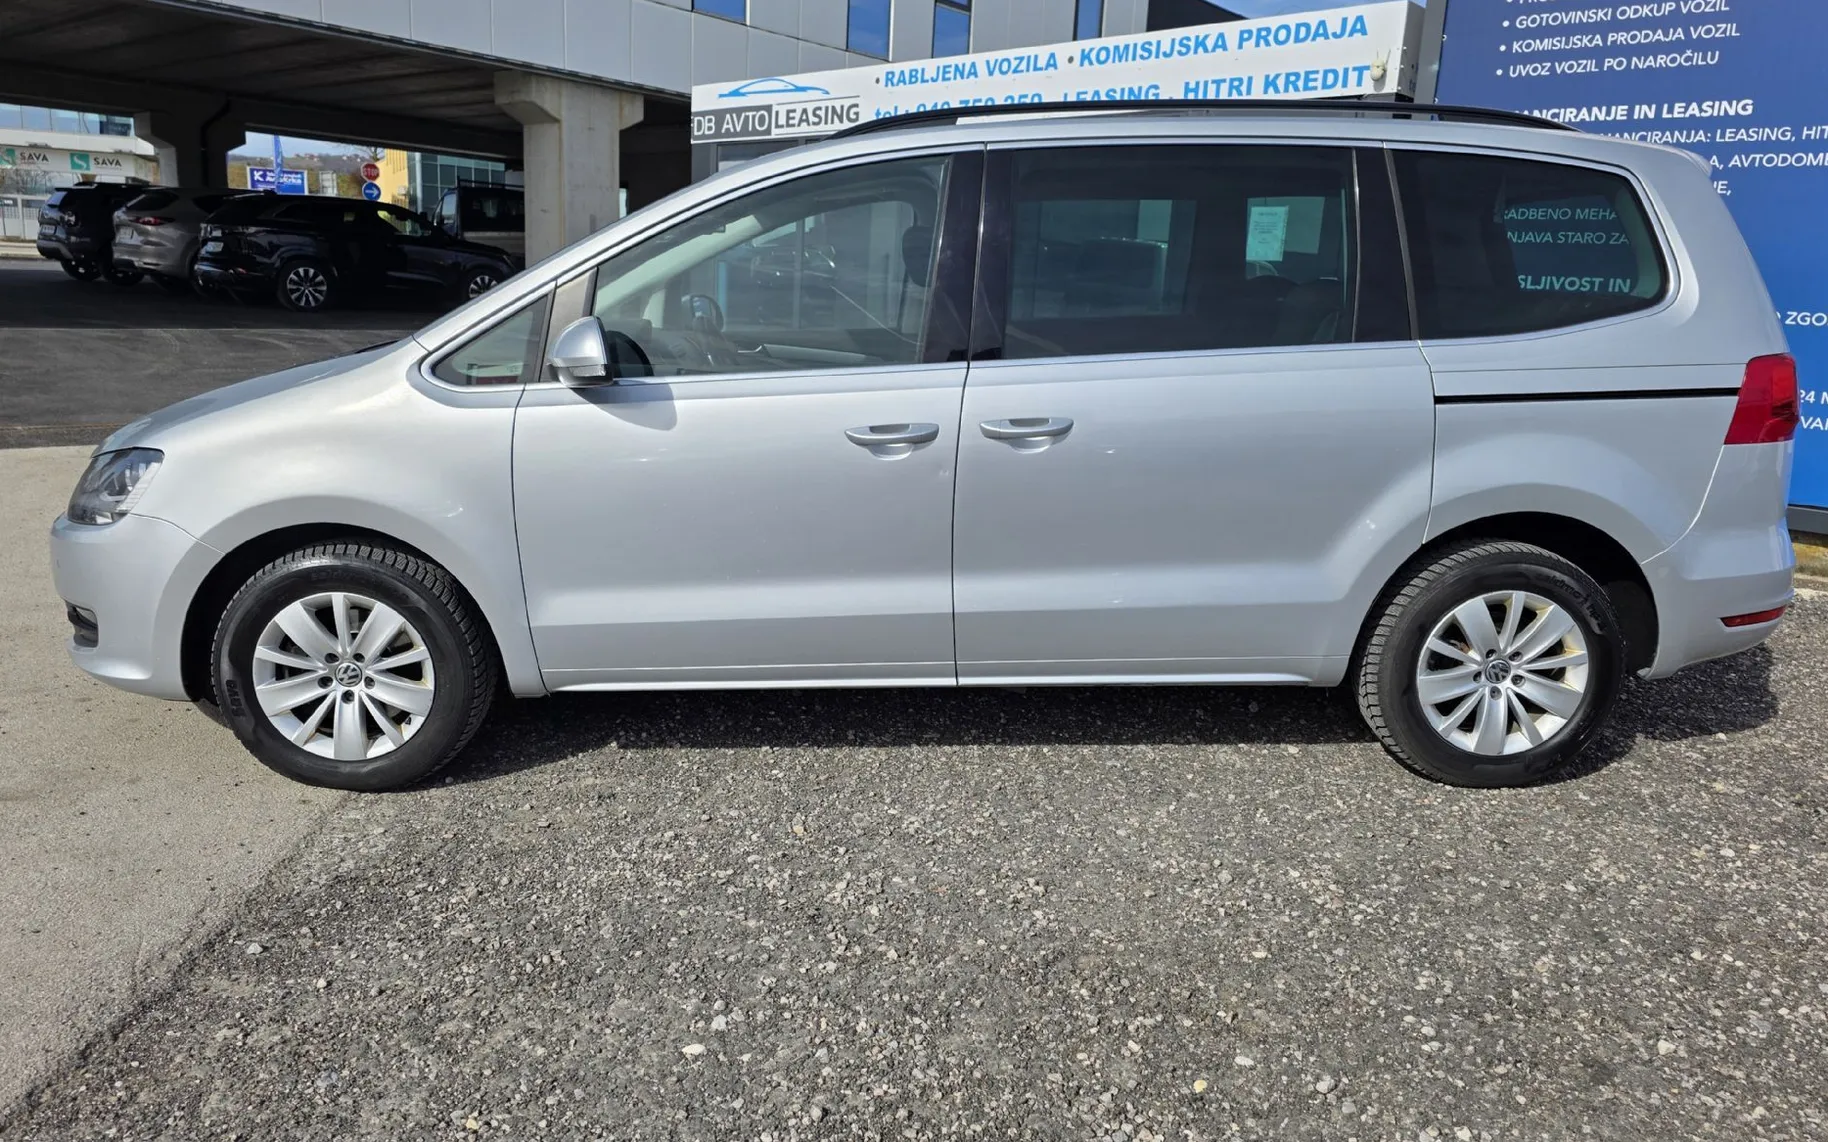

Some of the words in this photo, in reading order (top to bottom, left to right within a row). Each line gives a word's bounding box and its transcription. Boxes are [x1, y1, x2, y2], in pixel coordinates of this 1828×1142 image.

[1515, 8, 1612, 29] GOTOVINSKI
[1616, 2, 1676, 20] ODKUP
[1680, 0, 1730, 14] VOZIL
[1512, 34, 1603, 53] KOMISIJSKA
[1607, 27, 1685, 46] PRODAJA
[1690, 23, 1740, 39] VOZIL
[884, 62, 977, 88] RABLJENA
[985, 52, 1058, 77] VOZILA
[1079, 32, 1228, 67] KOMISIJSKA
[1237, 15, 1368, 50] PRODAJA
[1509, 62, 1552, 78] UVOZ
[1555, 59, 1599, 75] VOZIL
[1603, 57, 1627, 71] PO
[1631, 49, 1720, 70] NAROČILU
[1183, 76, 1253, 100] HITRI
[1262, 65, 1370, 95] KREDIT
[1514, 105, 1629, 123] NCIRANJE
[1633, 103, 1657, 120] IN
[1662, 99, 1755, 119] LEASING
[1600, 130, 1711, 144] NCIRANJA:
[1715, 127, 1796, 143] LEASING,
[20, 152, 50, 163] SAVA
[93, 157, 122, 168] SAVA
[362, 168, 380, 178] STOP
[1557, 231, 1606, 244] STARO
[1609, 232, 1630, 245] ZA
[1518, 274, 1604, 292] SLJIVOST
[1607, 278, 1631, 293] IN
